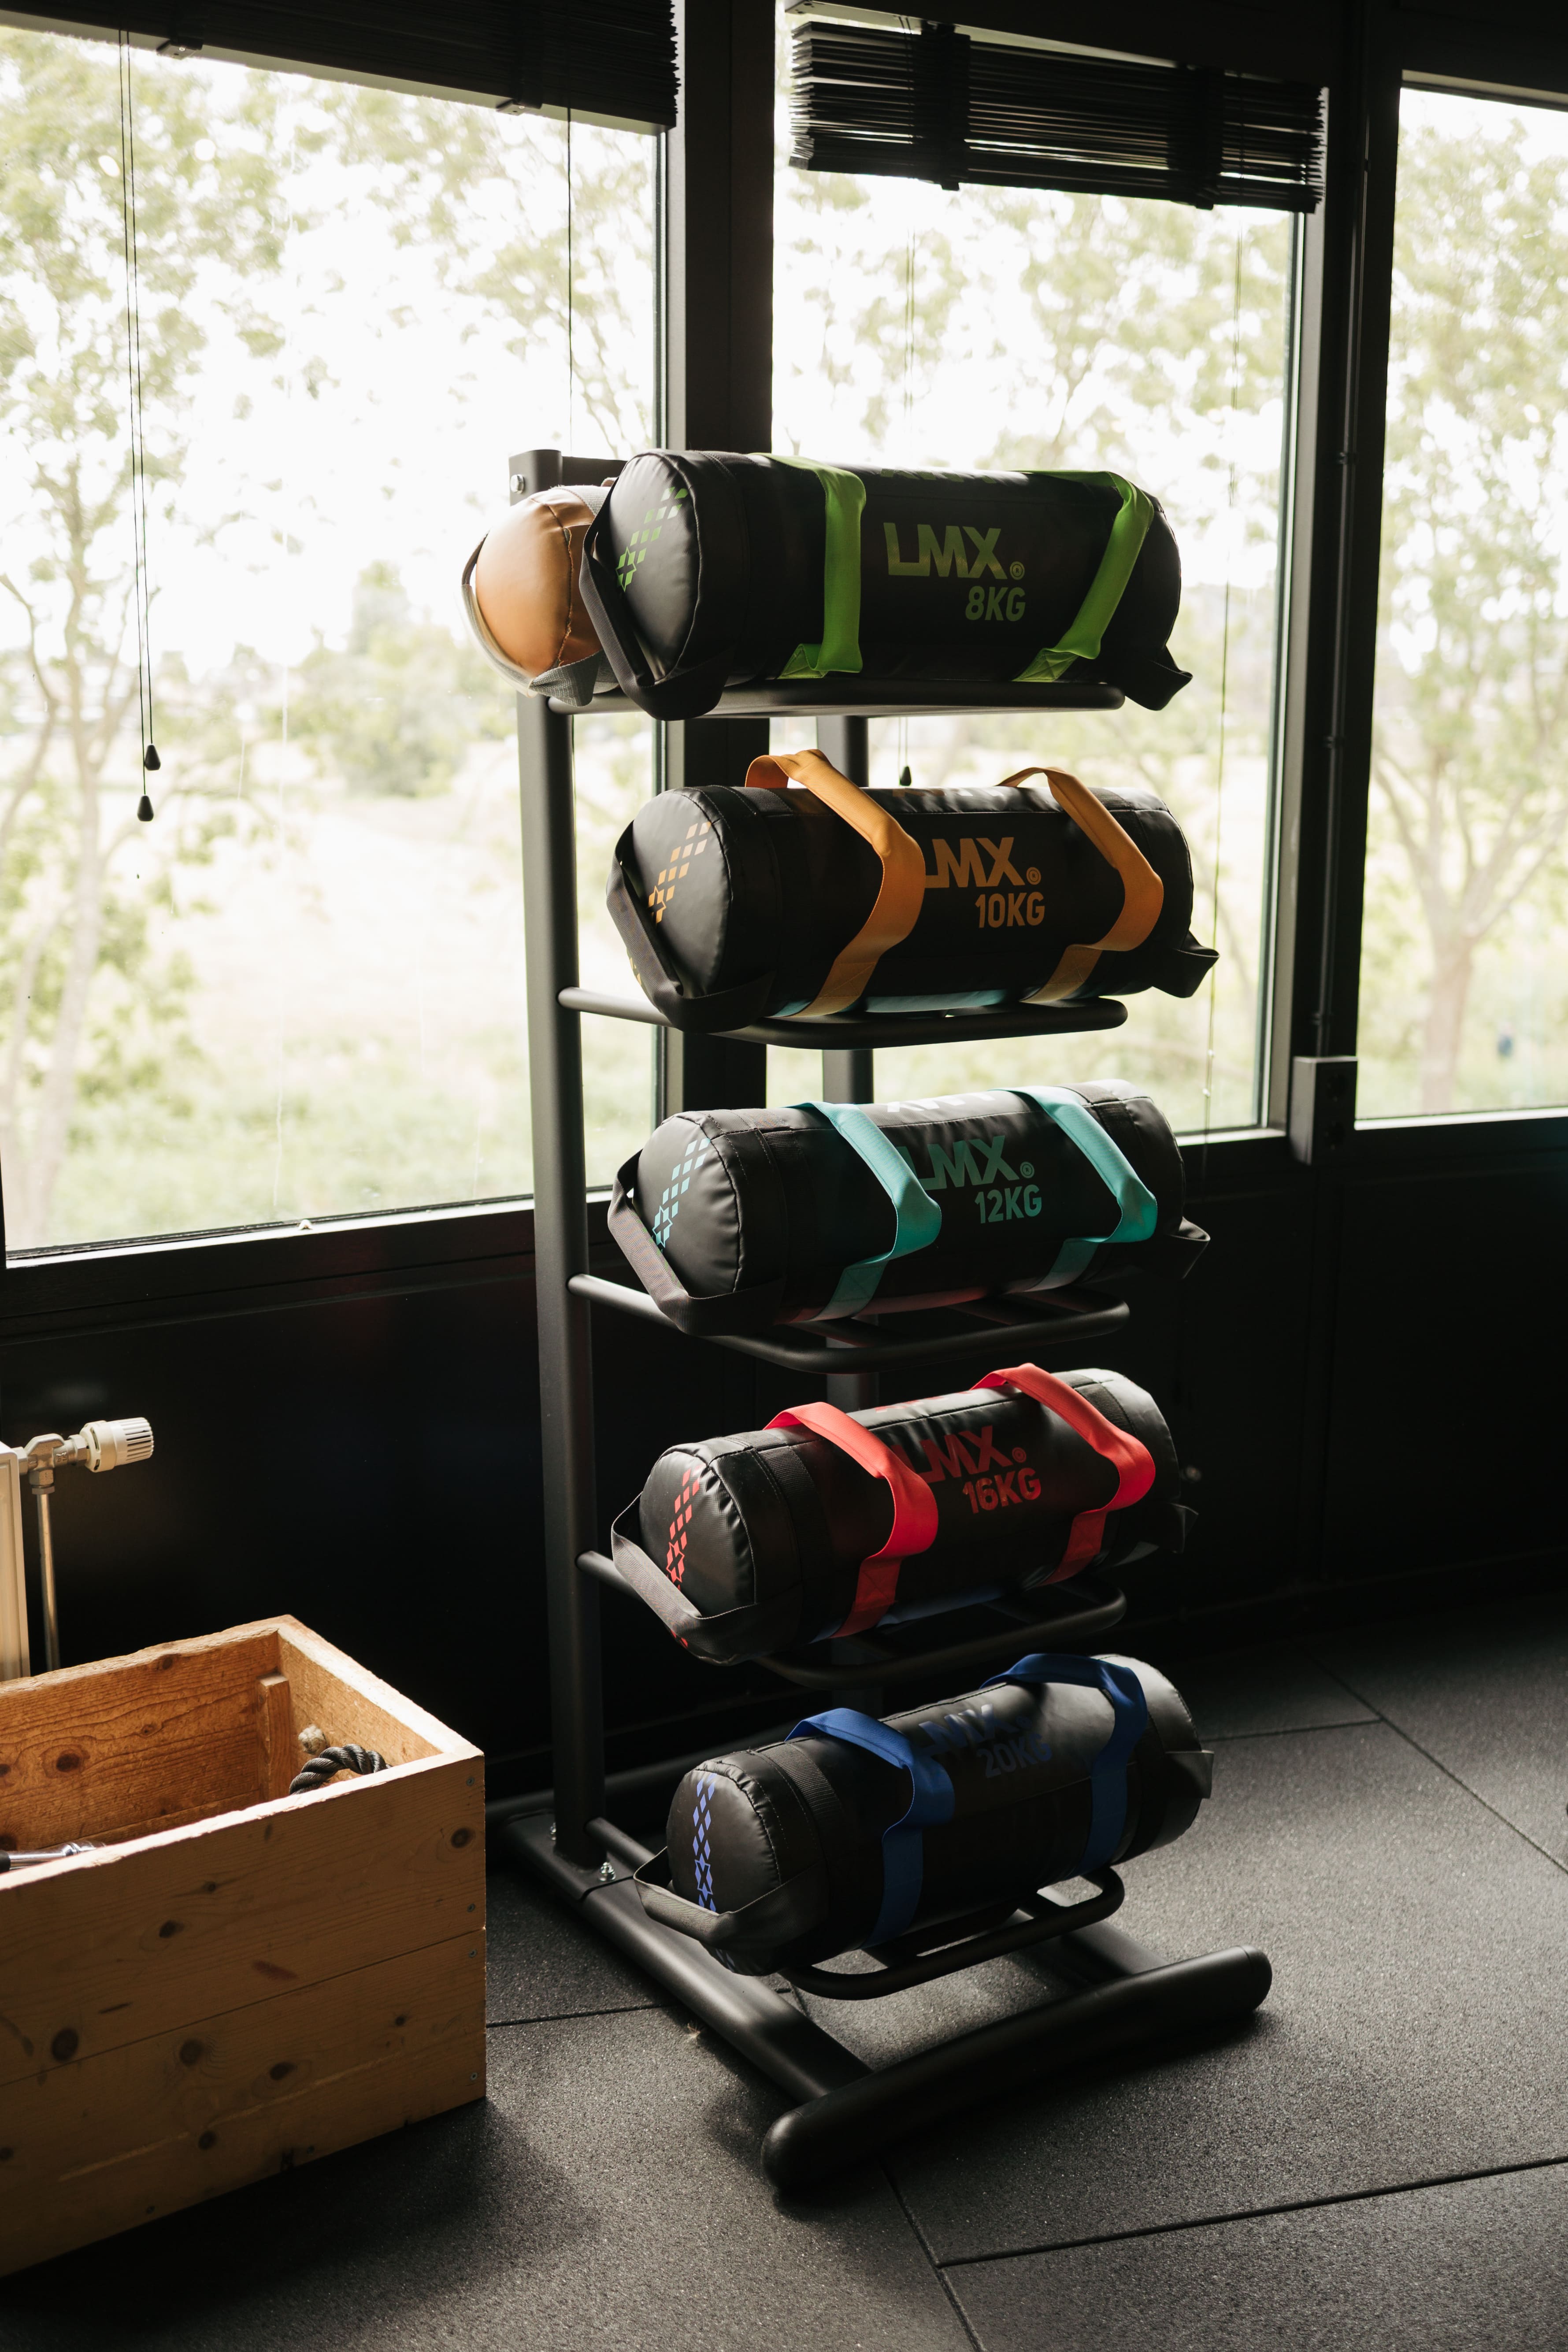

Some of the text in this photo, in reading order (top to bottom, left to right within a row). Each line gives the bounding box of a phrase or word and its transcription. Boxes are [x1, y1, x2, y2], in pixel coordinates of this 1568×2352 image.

[965, 586, 1026, 621] 8KG
[975, 891, 1045, 928] 10KG
[975, 1185, 1042, 1224] 12KG
[963, 1467, 1041, 1514] 16KG
[976, 1733, 1053, 1779] 20KG
